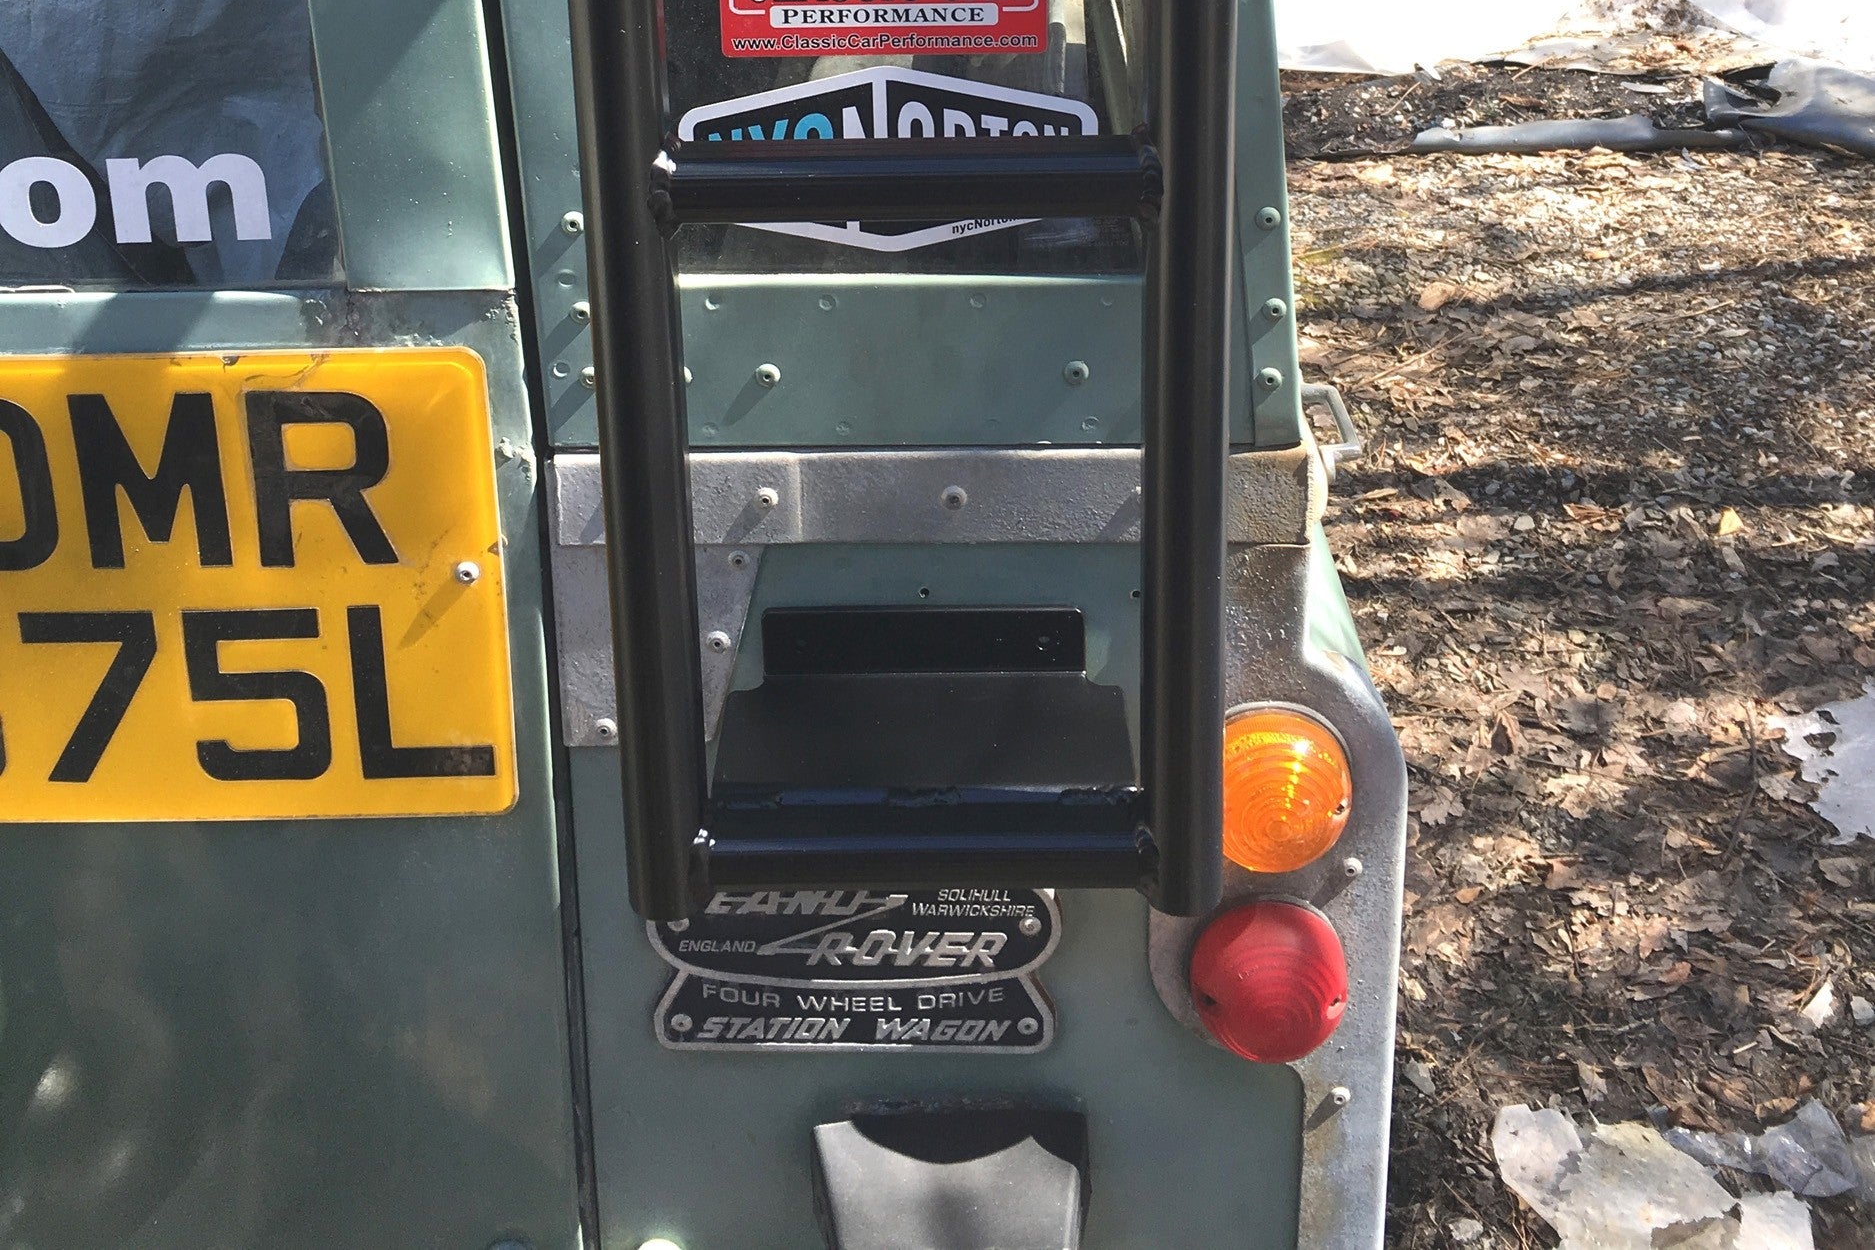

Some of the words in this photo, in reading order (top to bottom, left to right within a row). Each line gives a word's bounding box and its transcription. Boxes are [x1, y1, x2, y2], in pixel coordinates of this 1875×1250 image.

[782, 6, 985, 25] PERFORMANCE
[732, 33, 1039, 52] www.ClassicCarPerformance.com
[0, 605, 497, 782] 75L
[937, 889, 1011, 903] SOLIHULL
[912, 902, 1035, 918] WARWICKSHIRE
[678, 939, 756, 954] ENGLAND
[806, 929, 1008, 968] ROVER
[702, 983, 781, 1008] FOUR
[796, 995, 903, 1013] WHEEL
[917, 988, 1005, 1011] DRIVE
[697, 1016, 852, 1041] STATION
[874, 1017, 1013, 1042] WAGON
